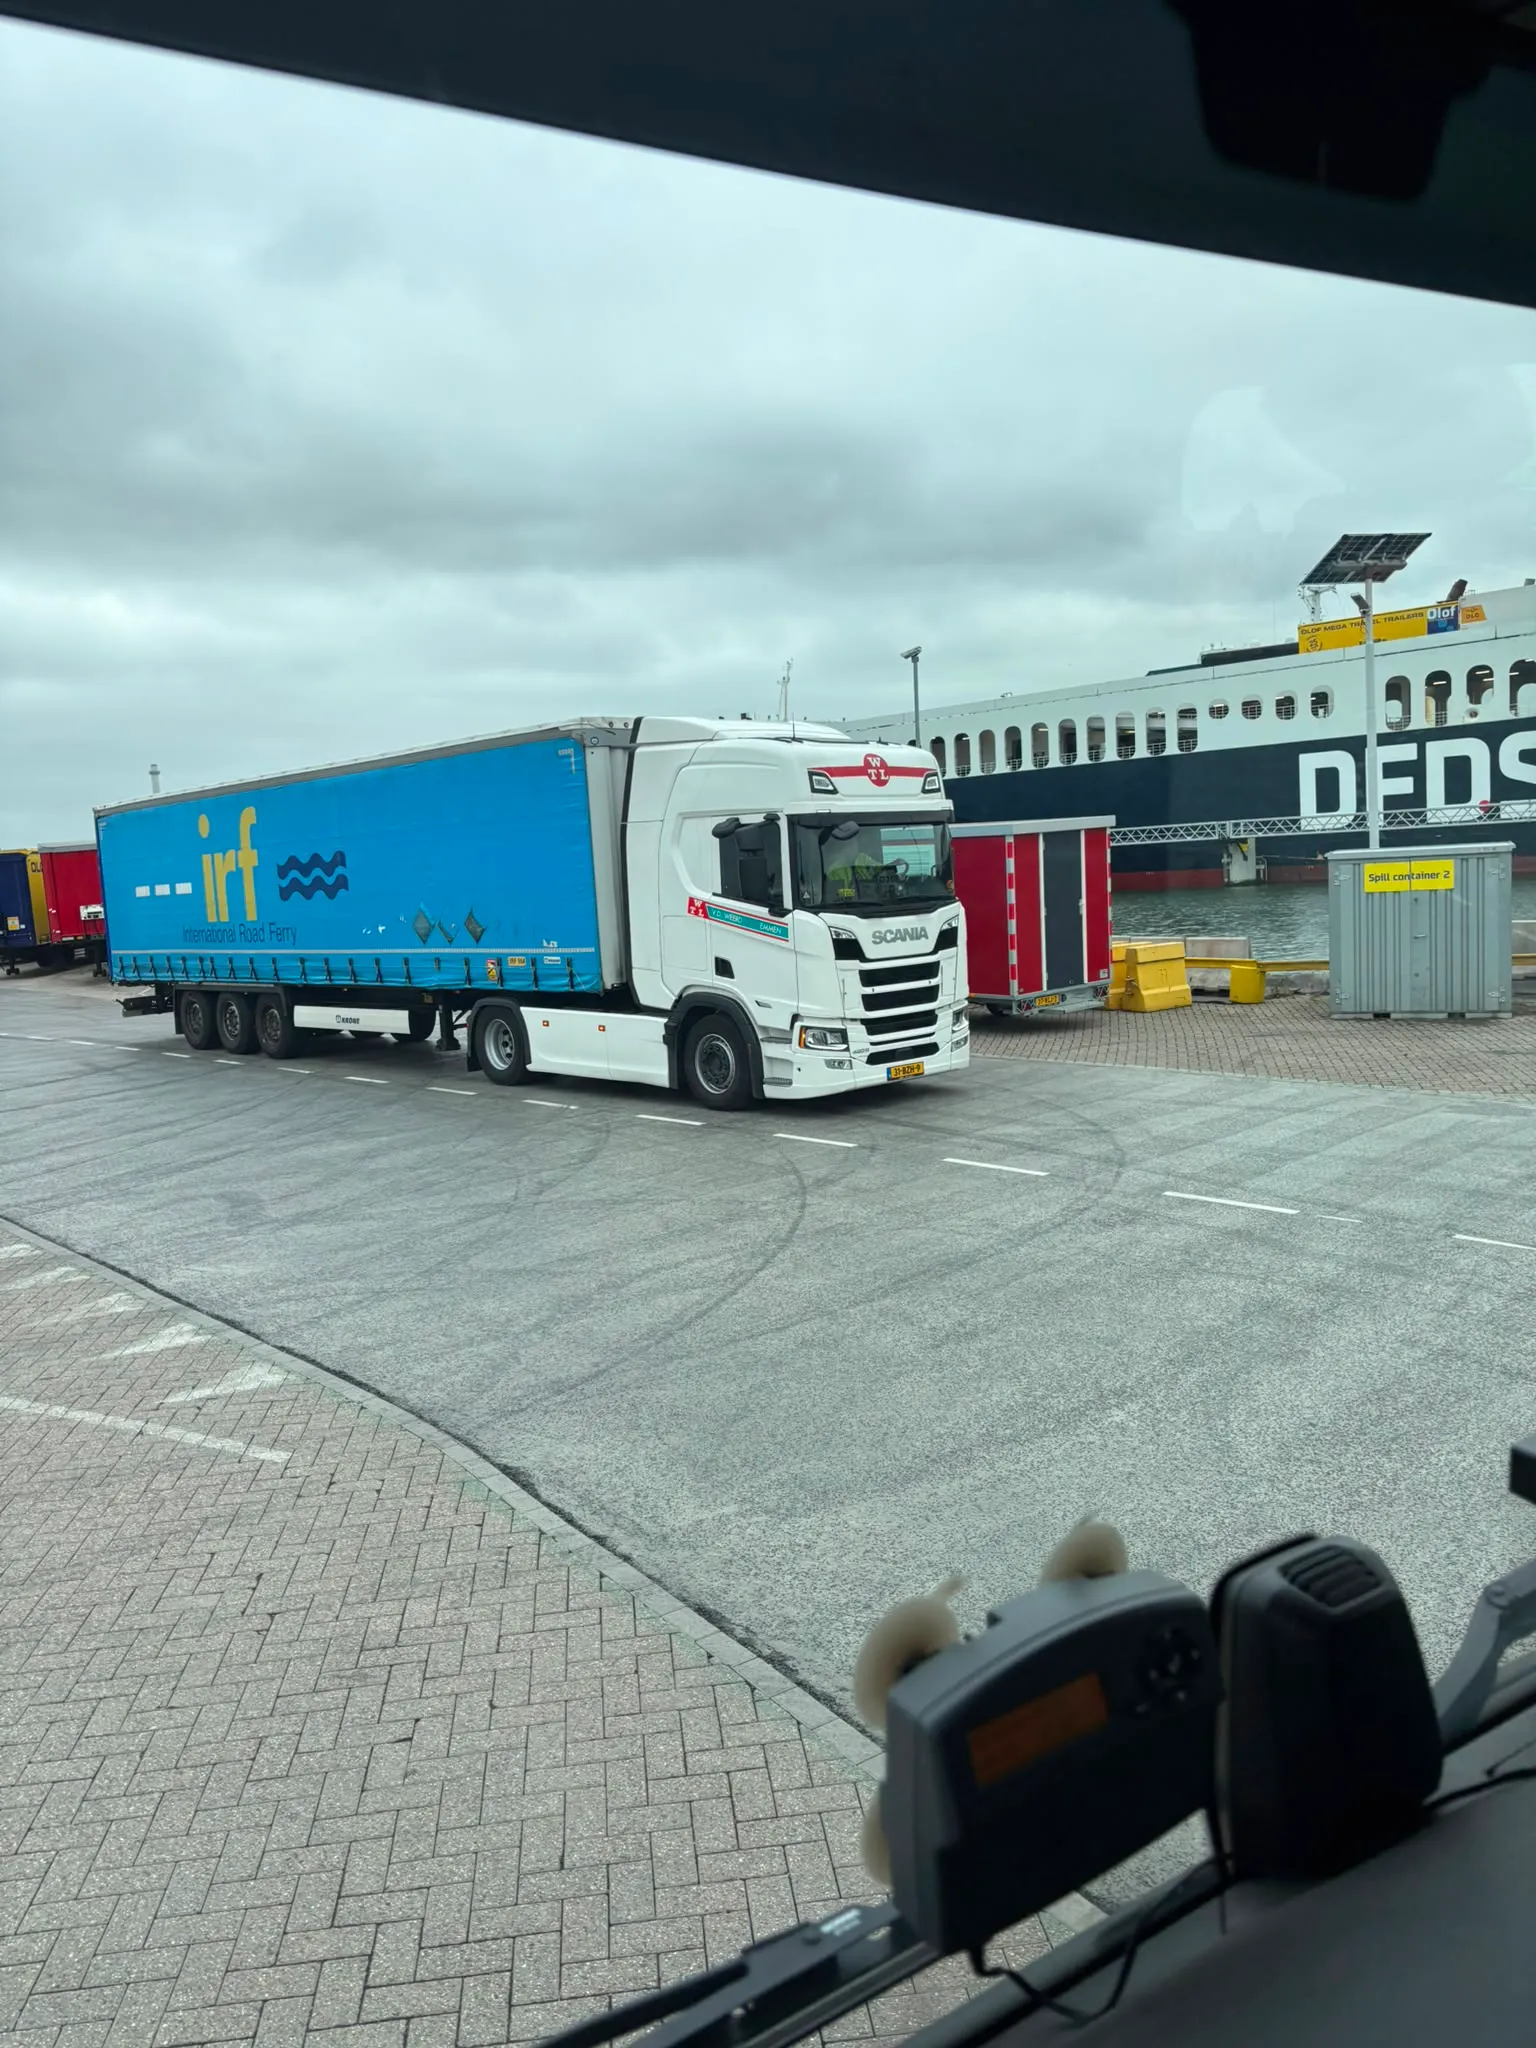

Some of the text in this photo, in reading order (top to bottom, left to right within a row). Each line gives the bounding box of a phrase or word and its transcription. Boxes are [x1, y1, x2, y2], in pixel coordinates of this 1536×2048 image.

[1427, 605, 1456, 621] Olof
[1323, 624, 1347, 632] MEGA
[1383, 612, 1424, 624] TRAILERS
[866, 756, 881, 767] W
[1299, 730, 1536, 830] DFDS
[198, 806, 259, 923] irf
[1368, 870, 1450, 883] Spill container 2
[182, 922, 297, 945] International Road Ferry
[759, 921, 782, 936] EMMEN
[871, 926, 929, 945] SCANIA
[341, 1016, 360, 1025] KRONE
[893, 1063, 921, 1077] 31-BZH-9
